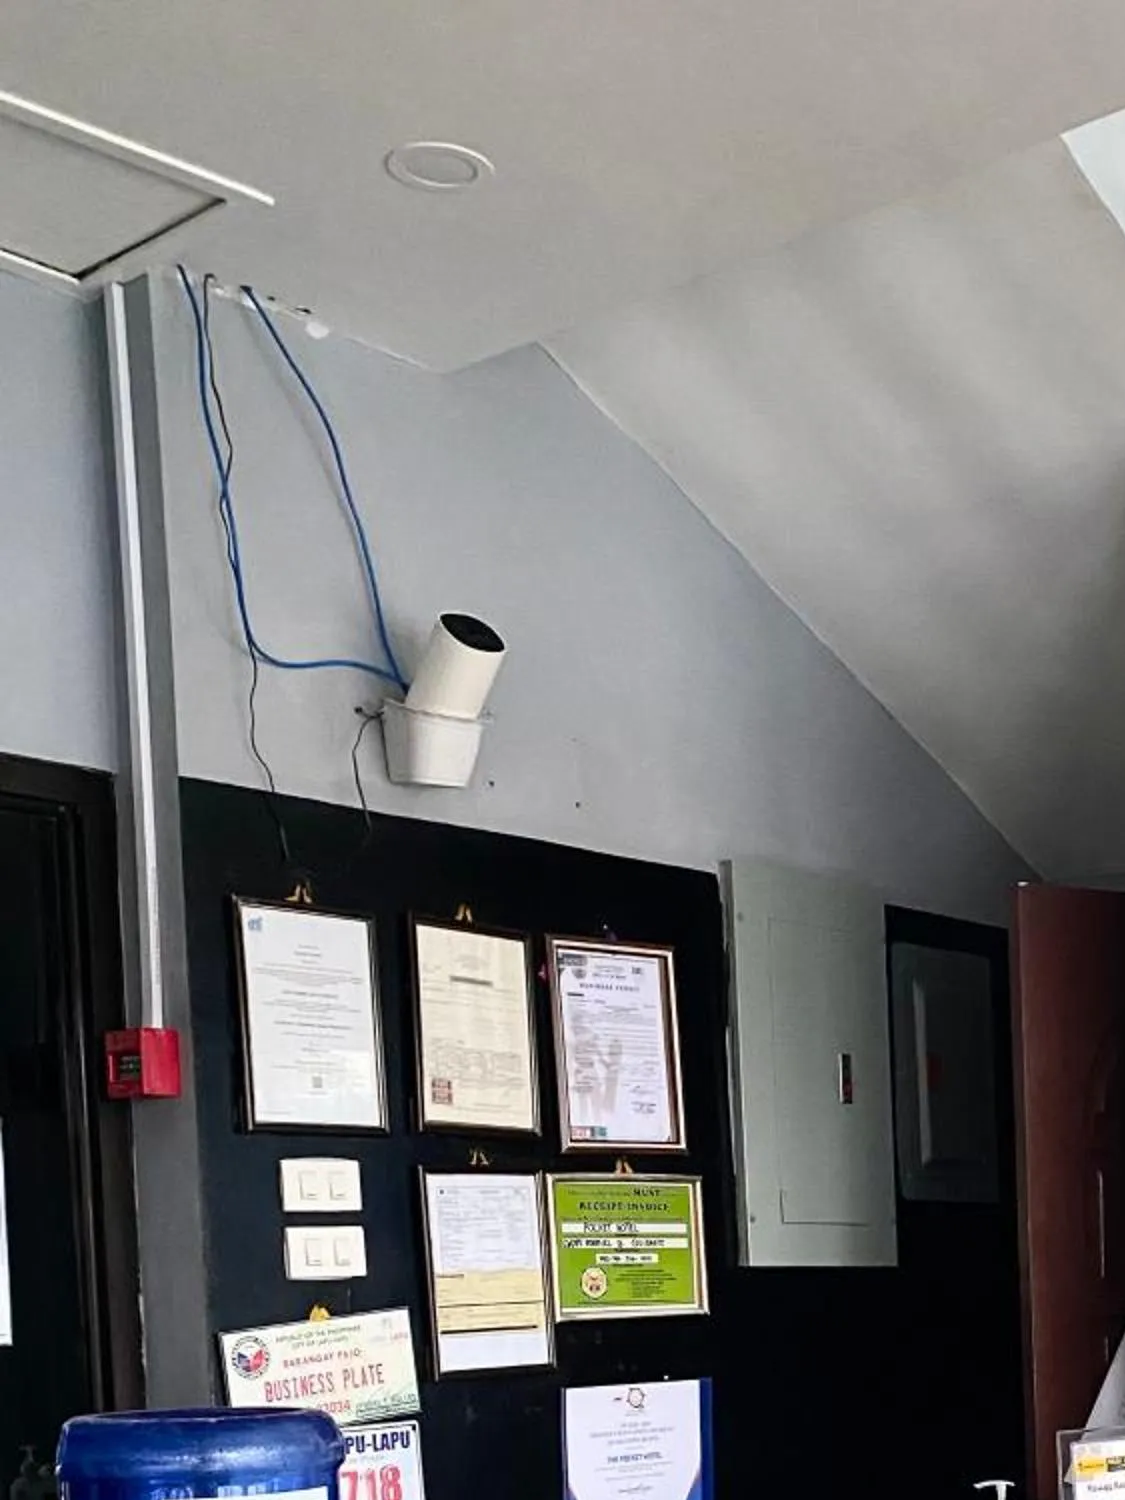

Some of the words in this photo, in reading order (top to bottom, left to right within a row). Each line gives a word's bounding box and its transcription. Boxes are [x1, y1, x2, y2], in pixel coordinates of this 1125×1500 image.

[283, 1351, 334, 1369] BARANGAY
[264, 1371, 334, 1403] BUSINESS
[342, 1363, 385, 1390] PLATE
[344, 1430, 410, 1454] PU-LAPU
